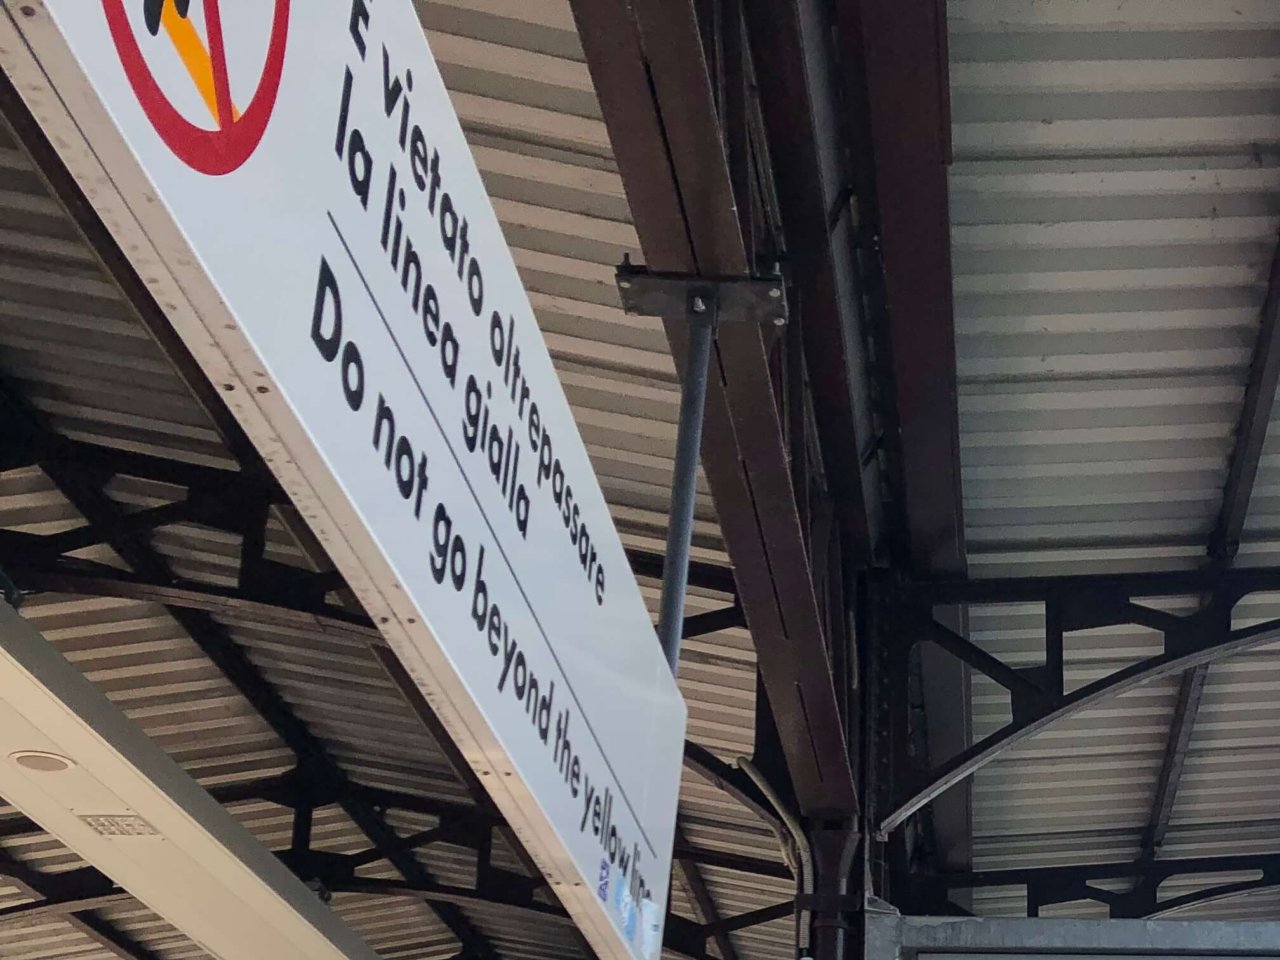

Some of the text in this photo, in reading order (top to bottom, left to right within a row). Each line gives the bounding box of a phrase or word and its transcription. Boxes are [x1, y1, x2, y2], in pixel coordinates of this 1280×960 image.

[311, 253, 364, 412] Do
[372, 392, 429, 521] not
[430, 502, 467, 592] go
[471, 543, 555, 745] beyond
[552, 707, 581, 799] the
[580, 772, 631, 878] yellow
[335, 63, 530, 540] la linea gialla
[382, 41, 484, 316] vietato
[490, 310, 605, 606] oltrepassare
